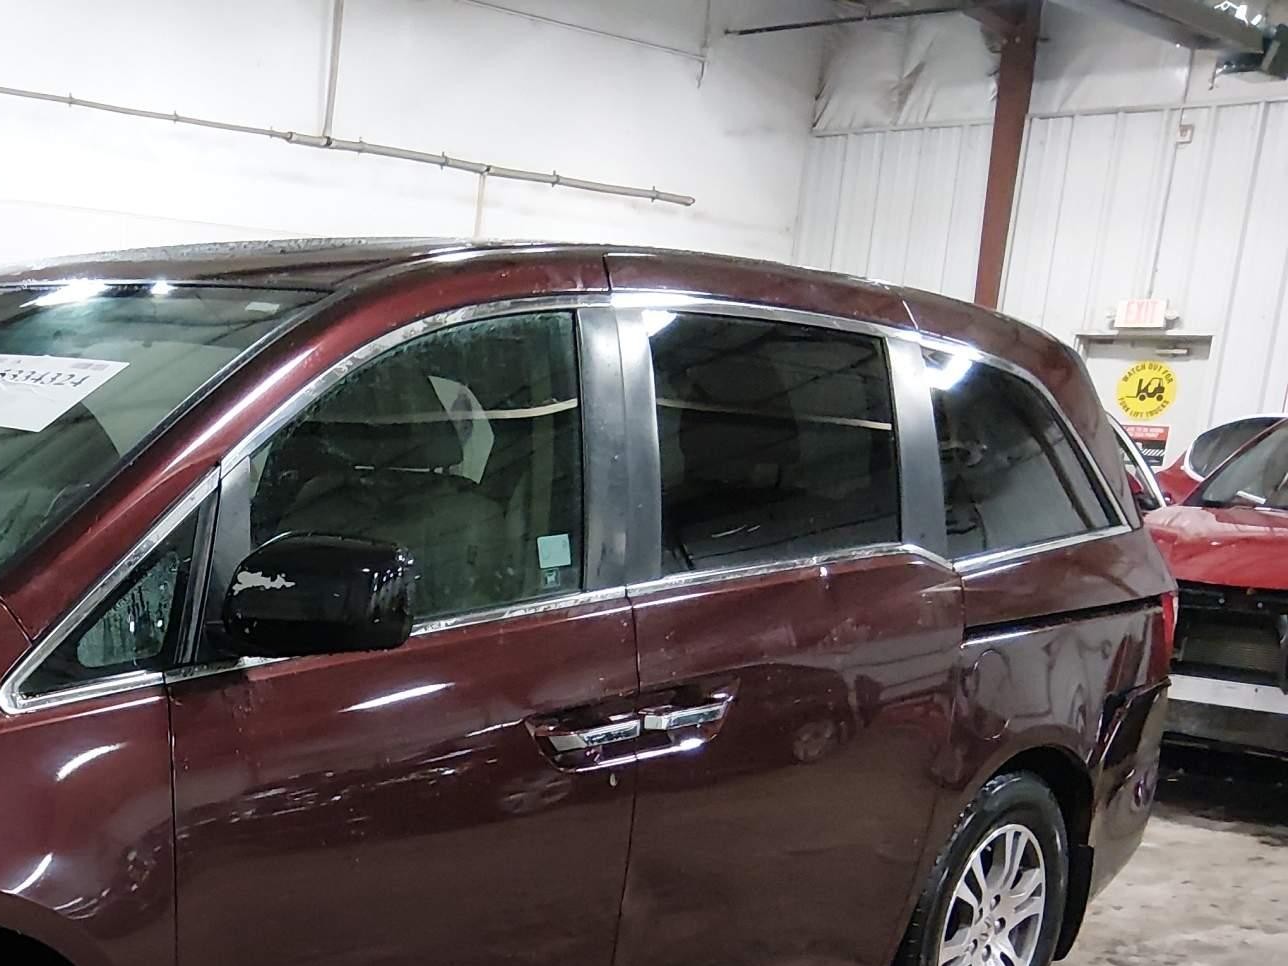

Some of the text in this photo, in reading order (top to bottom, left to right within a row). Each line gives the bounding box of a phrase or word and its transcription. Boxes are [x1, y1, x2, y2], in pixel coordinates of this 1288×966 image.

[1125, 300, 1160, 324] EXIT
[1122, 362, 1174, 384] WATCH OUT FOR
[1119, 397, 1130, 413] FORK
[1145, 400, 1170, 417] TRUCKS
